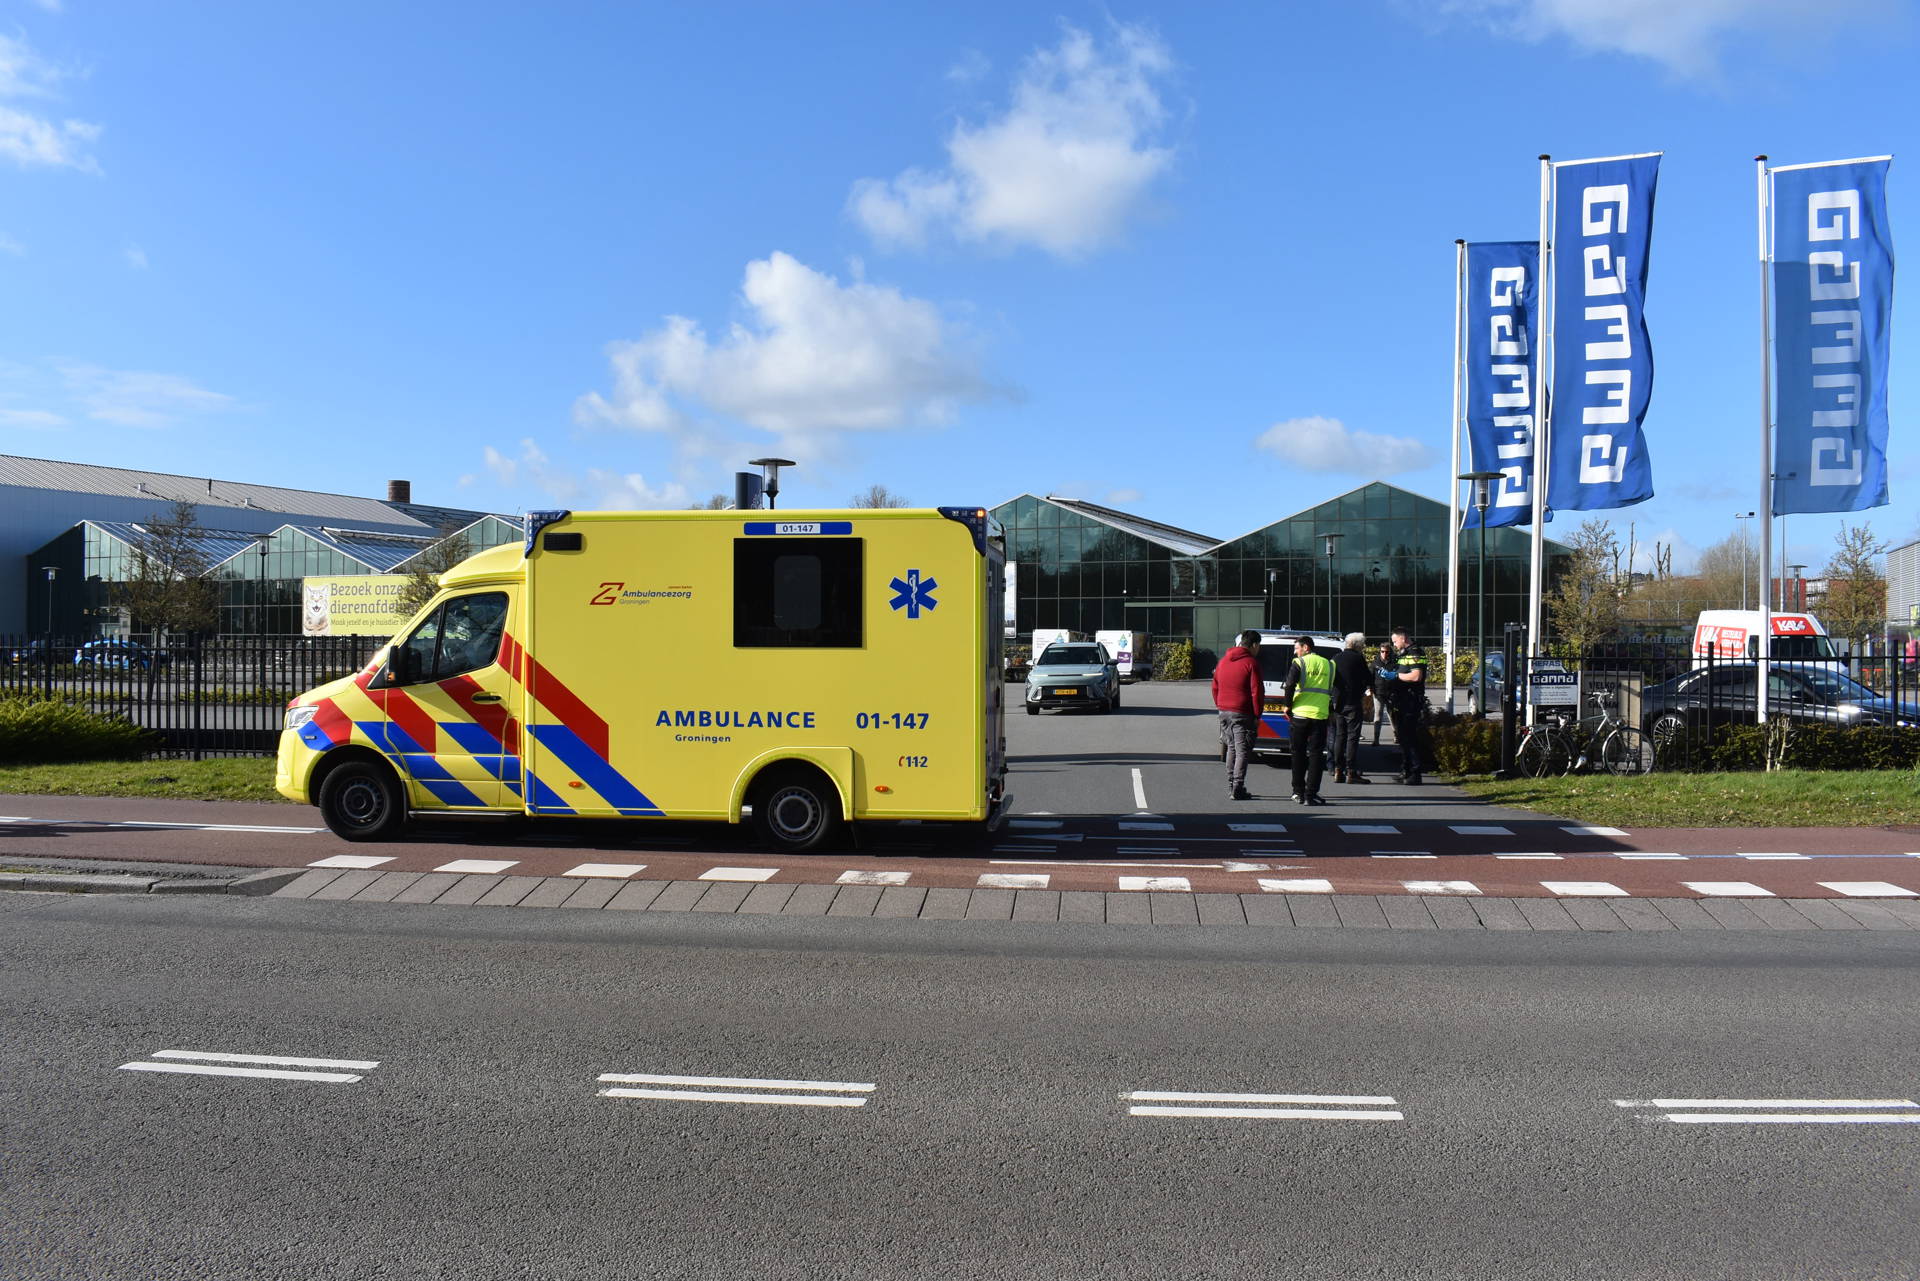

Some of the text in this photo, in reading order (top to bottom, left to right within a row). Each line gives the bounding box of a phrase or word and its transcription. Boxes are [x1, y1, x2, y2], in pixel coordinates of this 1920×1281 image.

[782, 525, 814, 533] 01-147
[330, 582, 372, 596] Bezoek
[374, 584, 403, 596] onze
[622, 590, 692, 599] Ambulancezorg
[655, 710, 816, 729] AMBULANCE
[856, 712, 929, 729] 01-147
[675, 734, 731, 744] Groningen
